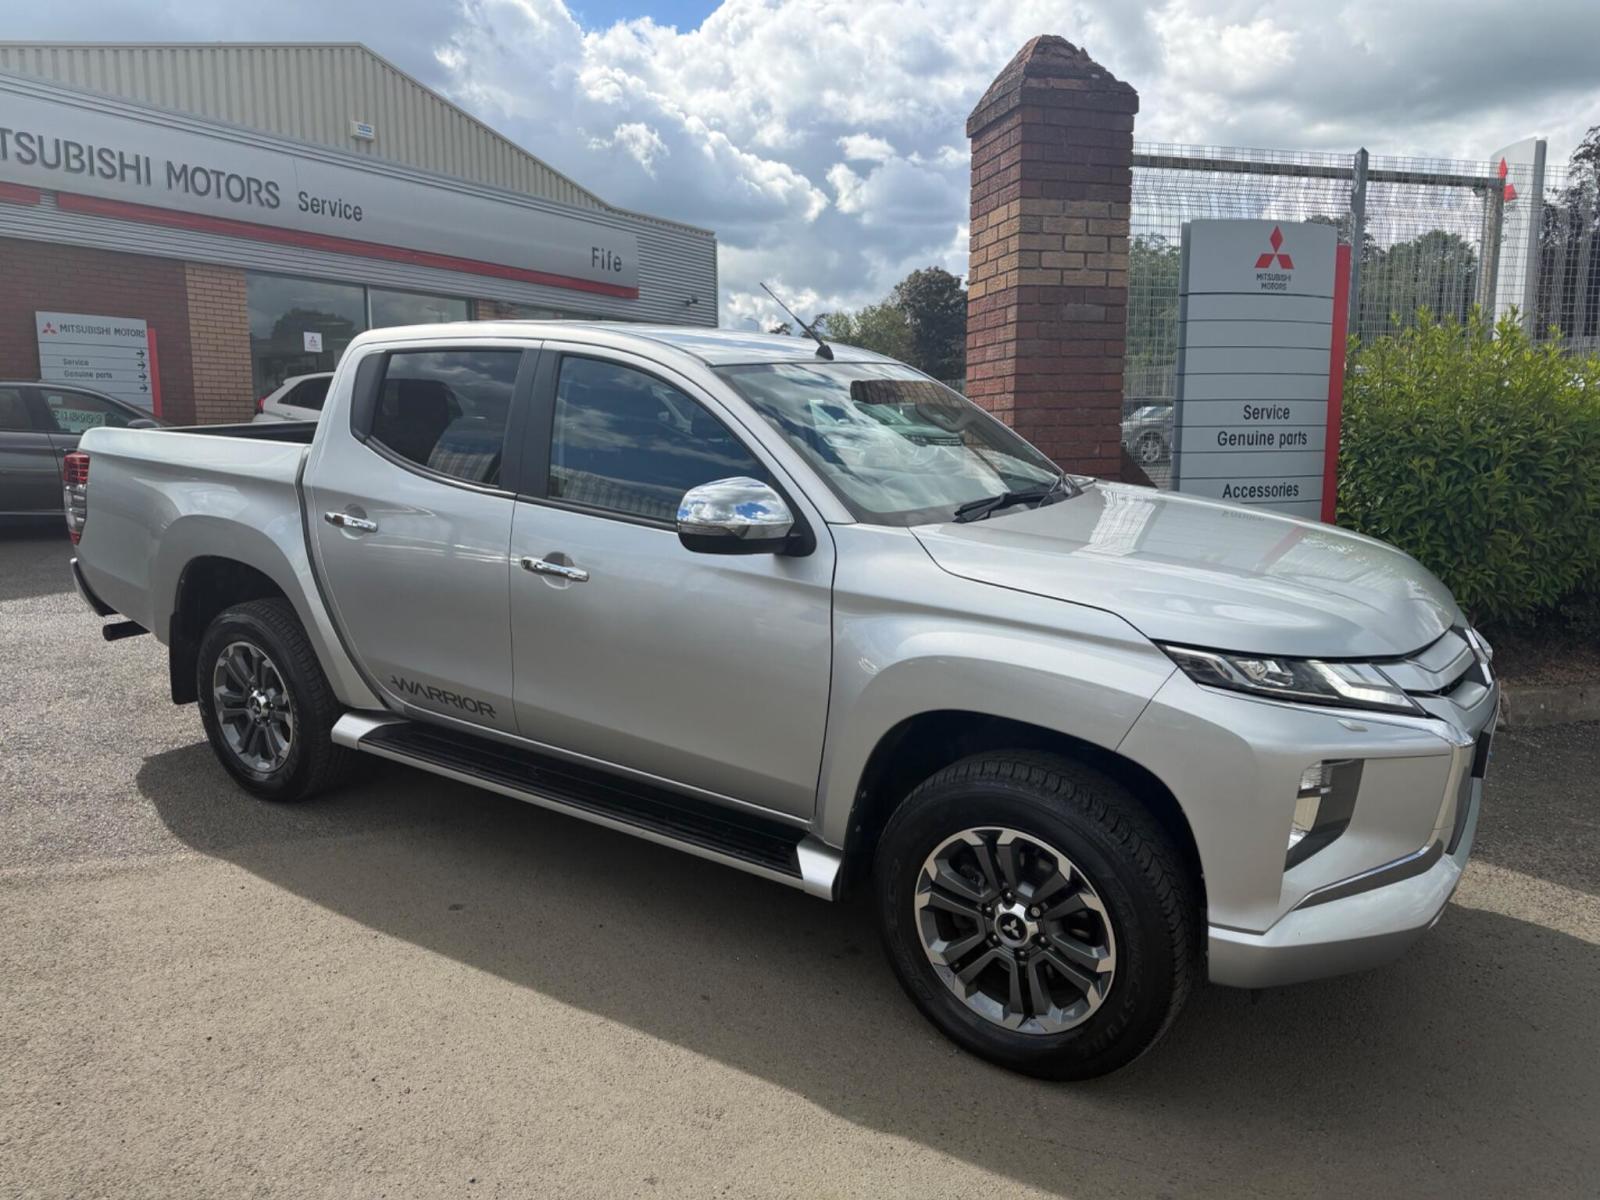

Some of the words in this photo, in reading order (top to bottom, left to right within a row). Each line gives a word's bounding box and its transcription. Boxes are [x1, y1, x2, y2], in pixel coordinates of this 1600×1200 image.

[166, 160, 281, 209] MOTORS
[297, 190, 363, 222] Service
[591, 246, 622, 272] Fife
[1256, 272, 1292, 282] MITSUBISHI
[1260, 282, 1288, 291] MOTORS
[59, 323, 112, 336] MITSUBISHI
[113, 327, 146, 338] MOTORS
[63, 358, 90, 367] Service
[64, 369, 94, 379] Genuine
[95, 371, 113, 380] parts
[1243, 404, 1290, 421] Service
[1217, 430, 1274, 447] Genuine
[1278, 430, 1308, 448] parts
[1222, 483, 1300, 499] Accessories
[390, 674, 497, 720] WARRIOR
